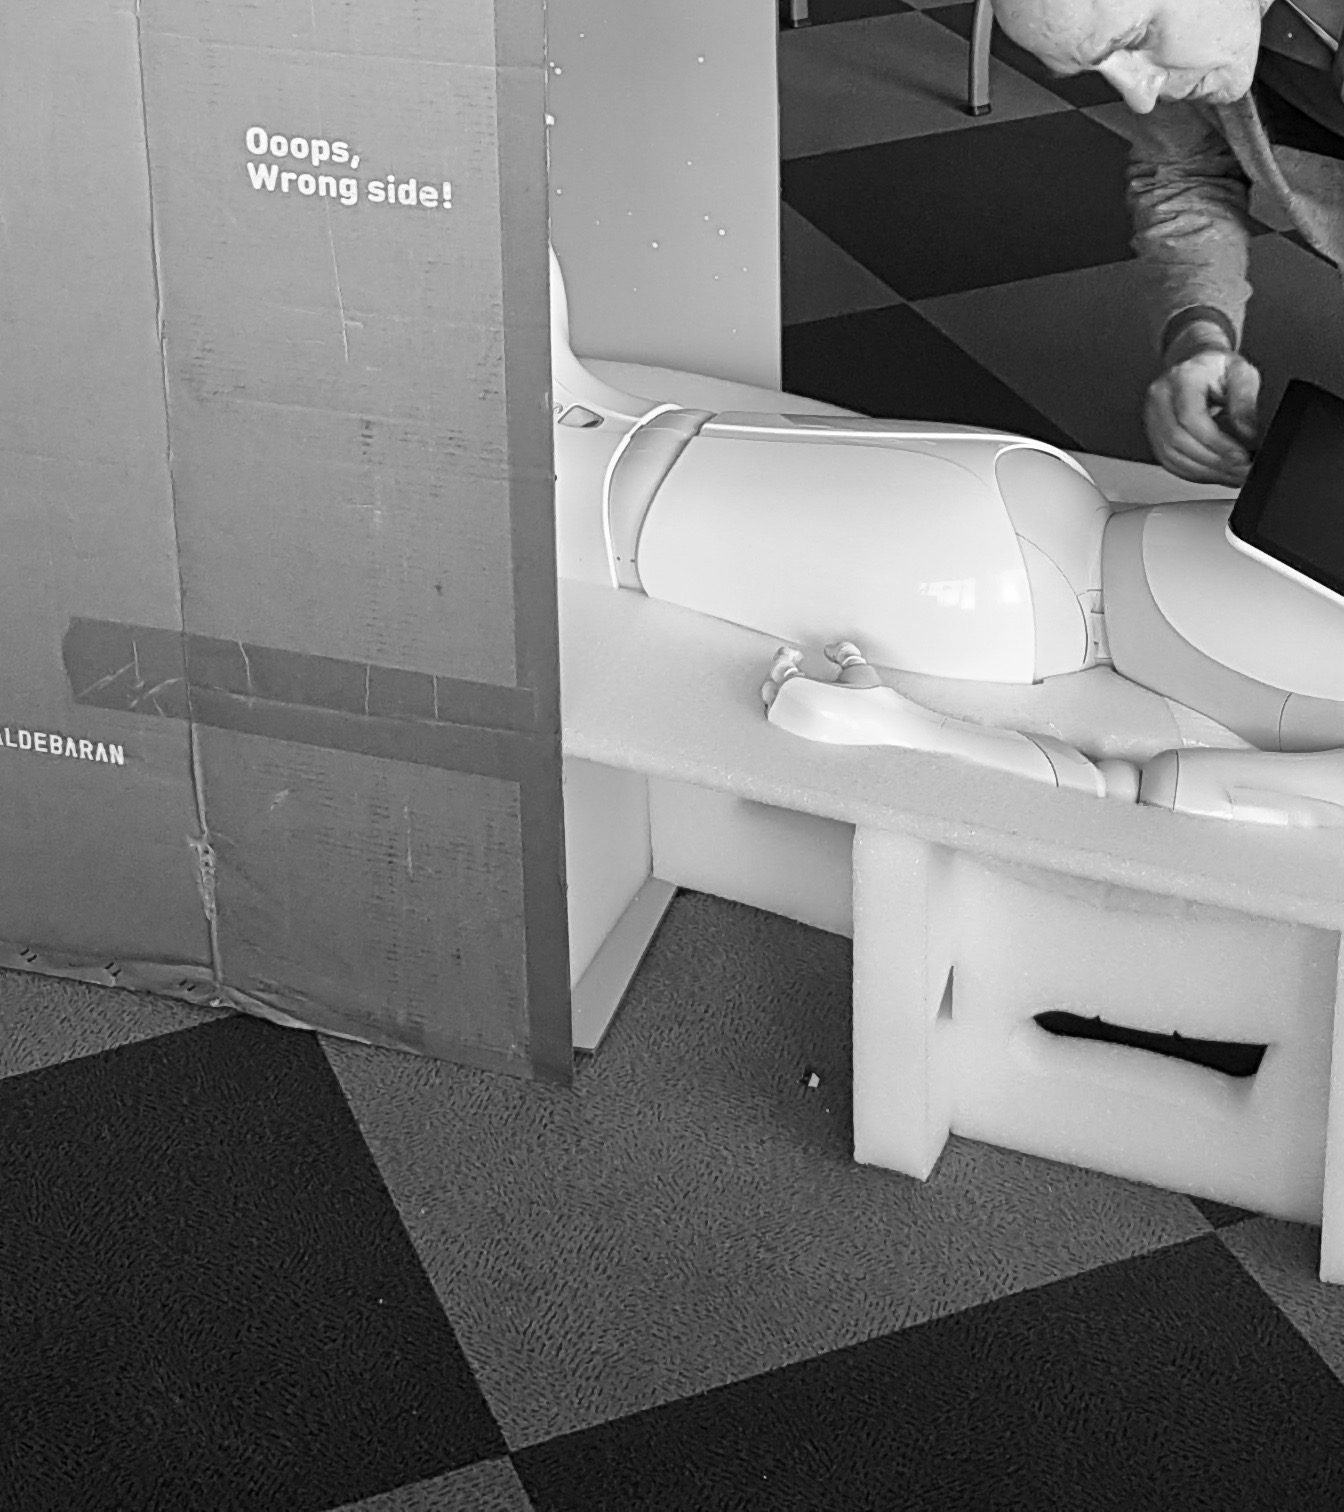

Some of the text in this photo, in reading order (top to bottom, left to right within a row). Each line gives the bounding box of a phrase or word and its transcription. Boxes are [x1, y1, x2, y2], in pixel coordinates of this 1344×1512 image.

[245, 126, 360, 169] Ooops,
[246, 162, 452, 209] Wrong side!
